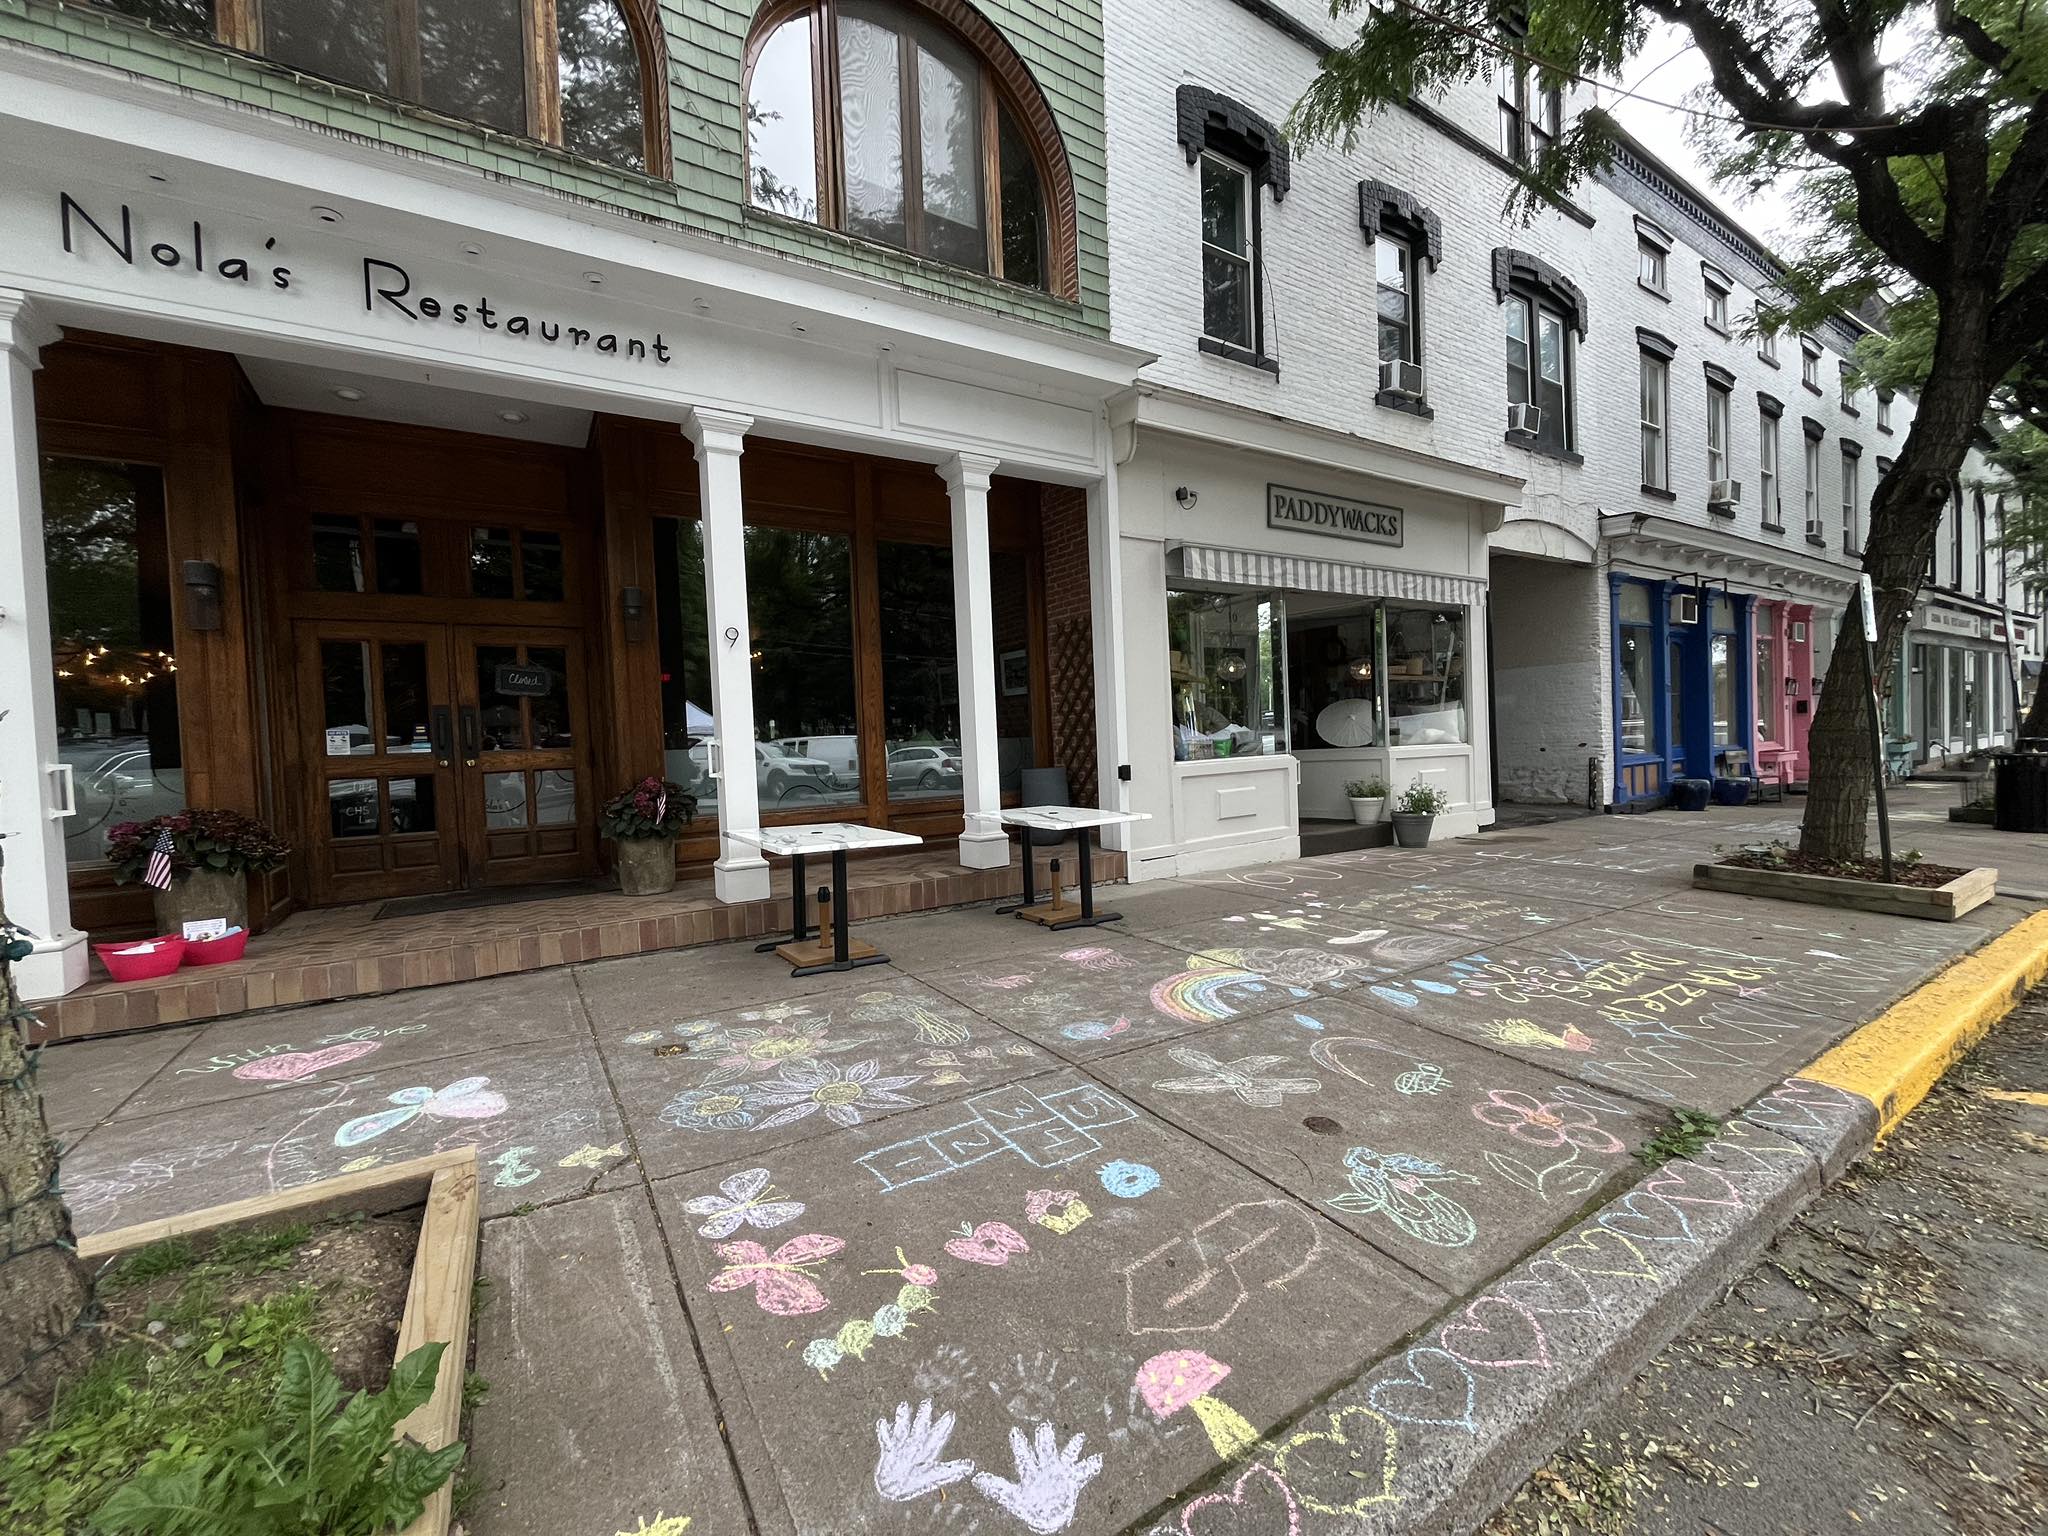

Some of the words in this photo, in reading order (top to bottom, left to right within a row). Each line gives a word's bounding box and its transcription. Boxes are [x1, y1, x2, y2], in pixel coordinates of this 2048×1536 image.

[60, 191, 291, 289] Nola's
[363, 257, 671, 363] Restaurant
[1274, 495, 1398, 536] PADDYWACKS
[725, 627, 739, 648] 9
